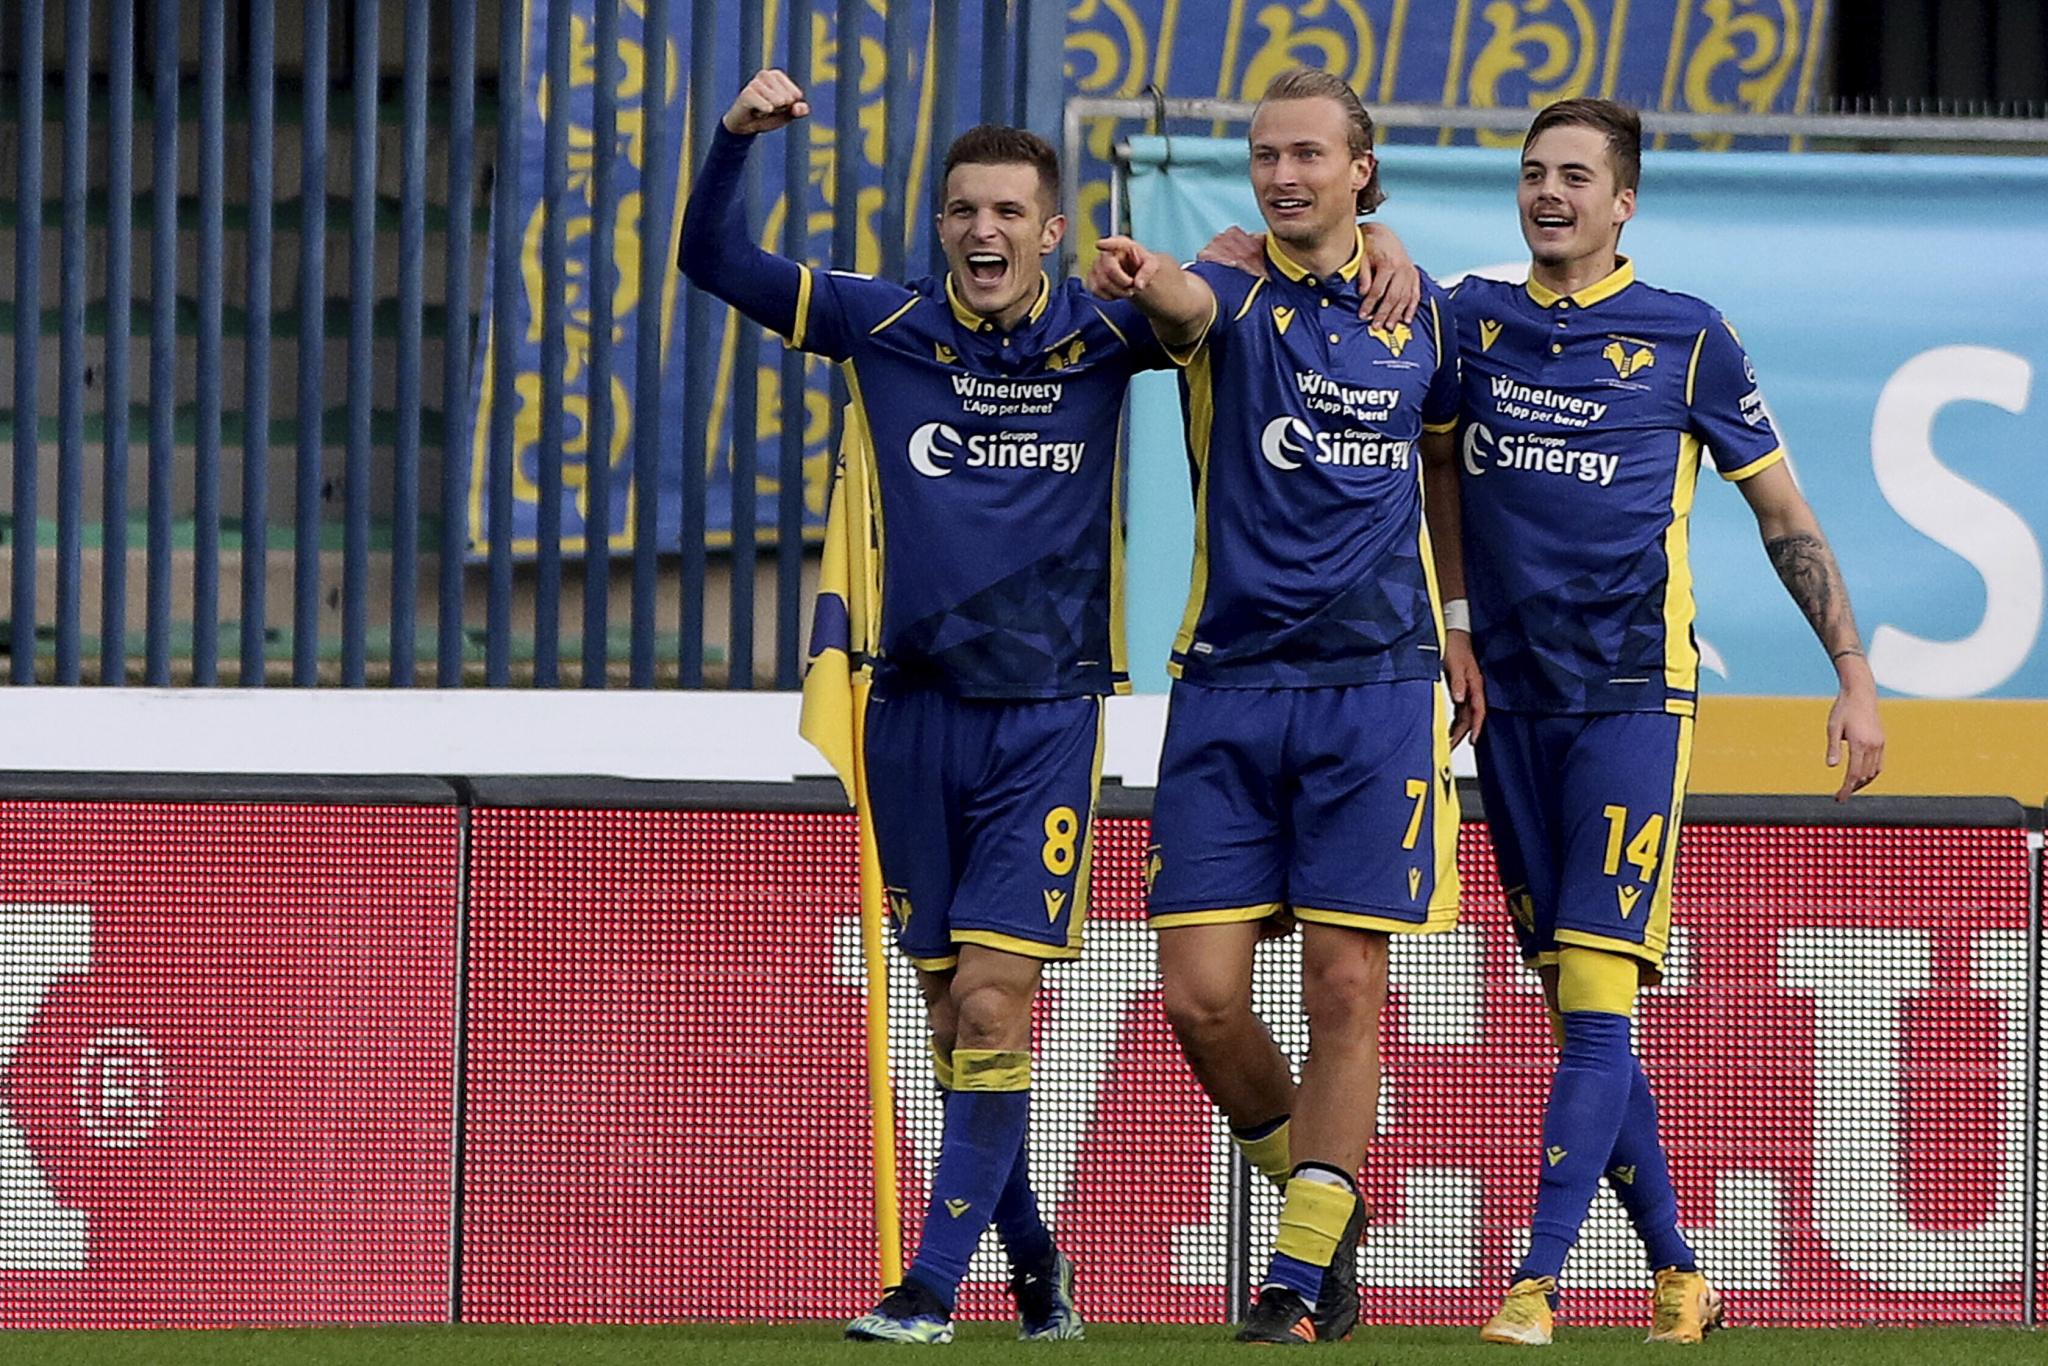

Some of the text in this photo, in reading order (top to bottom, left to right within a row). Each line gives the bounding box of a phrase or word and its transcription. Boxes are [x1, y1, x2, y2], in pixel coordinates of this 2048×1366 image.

[952, 372, 1062, 402] Winelivery
[1491, 374, 1608, 421] Winelivery
[999, 405, 1020, 416] per
[1021, 402, 1053, 414] bere!
[1530, 410, 1553, 421] per
[966, 434, 1086, 475] Sinergy
[999, 430, 1039, 443] Gruppo
[1315, 431, 1414, 471] Sinergy
[1344, 428, 1382, 442] Gruppo
[1528, 433, 1567, 448] Gruppo
[1496, 435, 1620, 487] Sinergy
[1402, 778, 1429, 850] 7
[1042, 805, 1079, 876] 8
[1603, 804, 1665, 884] 14
